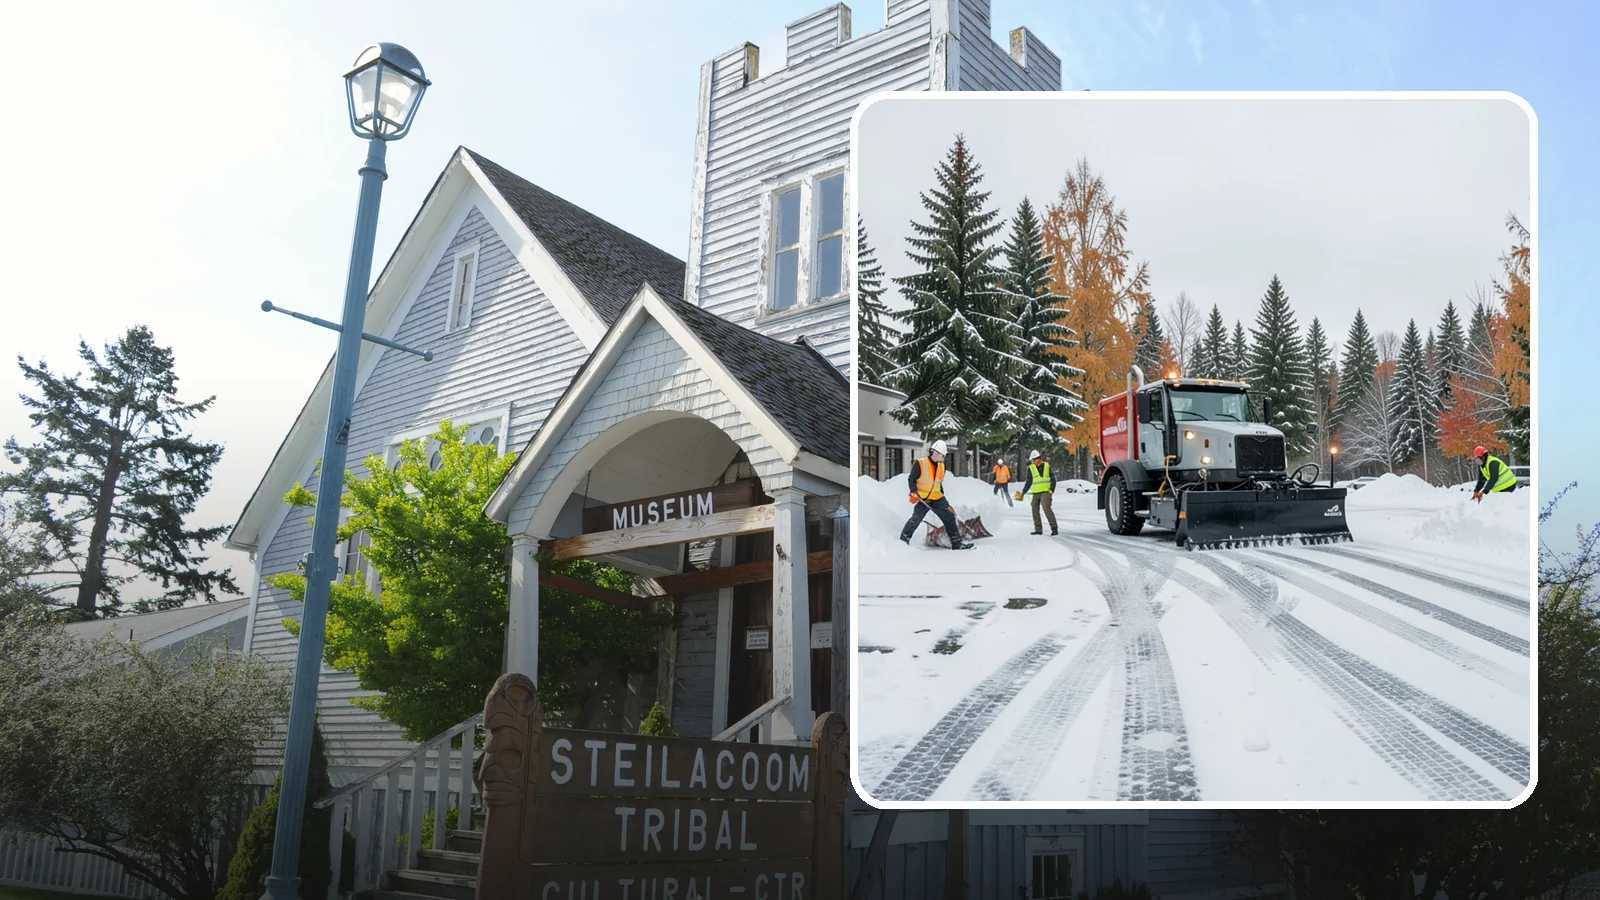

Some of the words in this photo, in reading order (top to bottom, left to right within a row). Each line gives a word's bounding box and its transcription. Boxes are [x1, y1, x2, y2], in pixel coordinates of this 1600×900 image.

[613, 492, 713, 530] MUSEUM
[551, 739, 809, 792] STEILACOOM
[615, 807, 757, 852] TRIBAL
